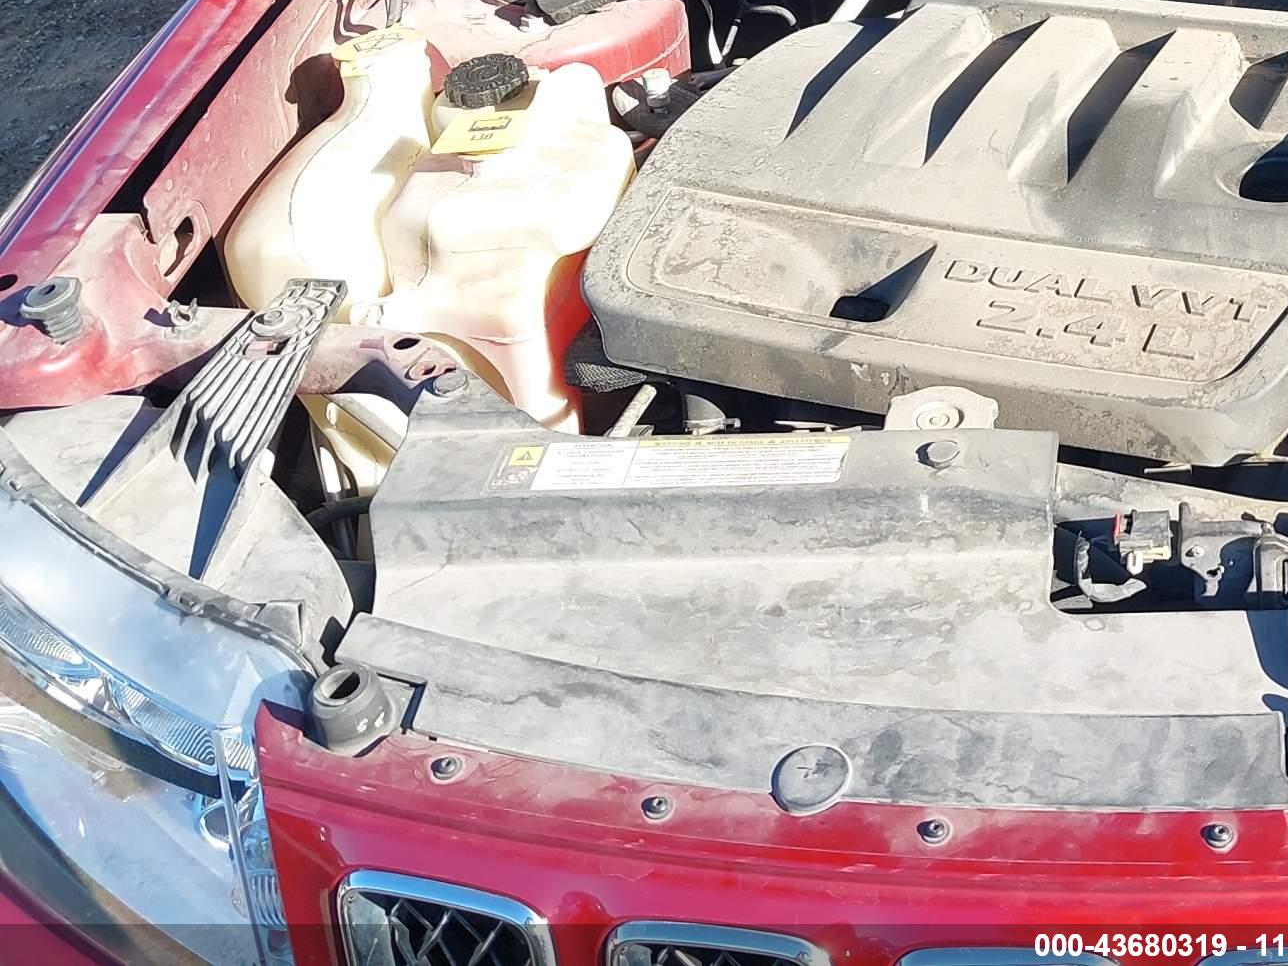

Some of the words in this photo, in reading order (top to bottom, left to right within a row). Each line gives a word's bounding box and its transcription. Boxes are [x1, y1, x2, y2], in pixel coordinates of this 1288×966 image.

[943, 259, 1112, 303] DUAL
[1131, 283, 1269, 323] VVT
[975, 299, 1197, 360] 2.4L
